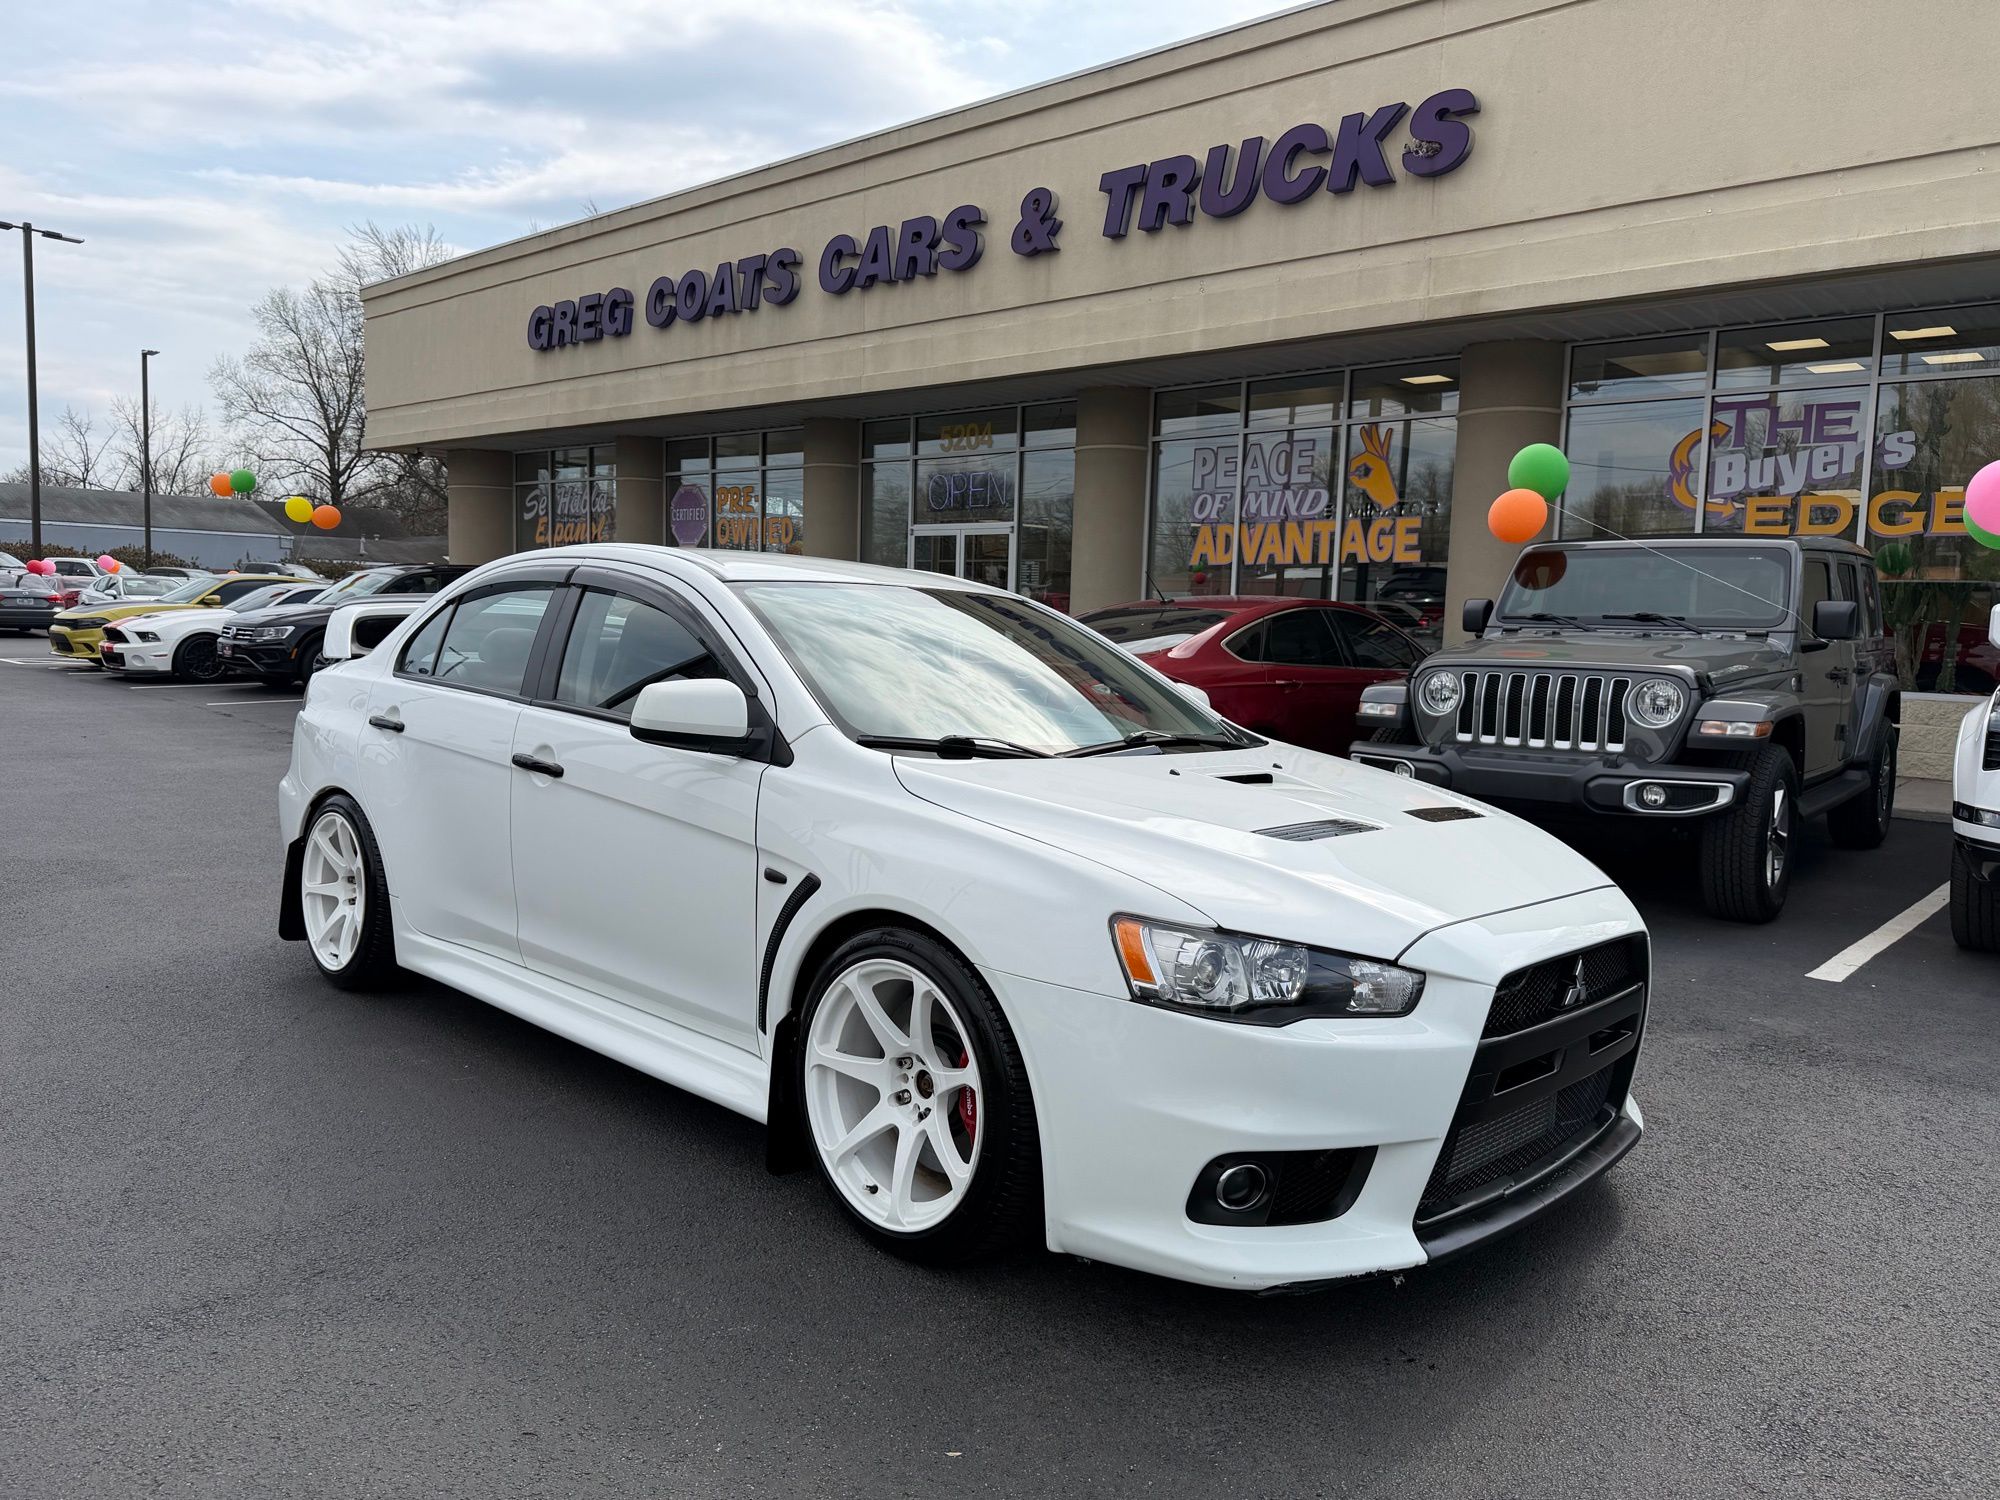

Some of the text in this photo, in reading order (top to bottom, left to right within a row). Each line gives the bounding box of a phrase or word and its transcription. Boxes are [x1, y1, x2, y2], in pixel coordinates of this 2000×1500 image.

[527, 88, 1481, 351] GREG COATS CARS & TRUCKS
[939, 422, 994, 452] 5204
[1713, 398, 1862, 449] THE
[1192, 438, 1316, 490] PEACE
[523, 488, 547, 520] Se
[717, 486, 759, 514] PRE-
[928, 471, 1007, 510] OPEN
[1192, 488, 1330, 520] OF MIND
[672, 507, 706, 521] CERTIFIED
[1744, 490, 1968, 538] EDGE
[717, 517, 794, 545] OWNED
[1189, 516, 1422, 566] ADVANTAGE
[965, 1085, 973, 1116] rembo
